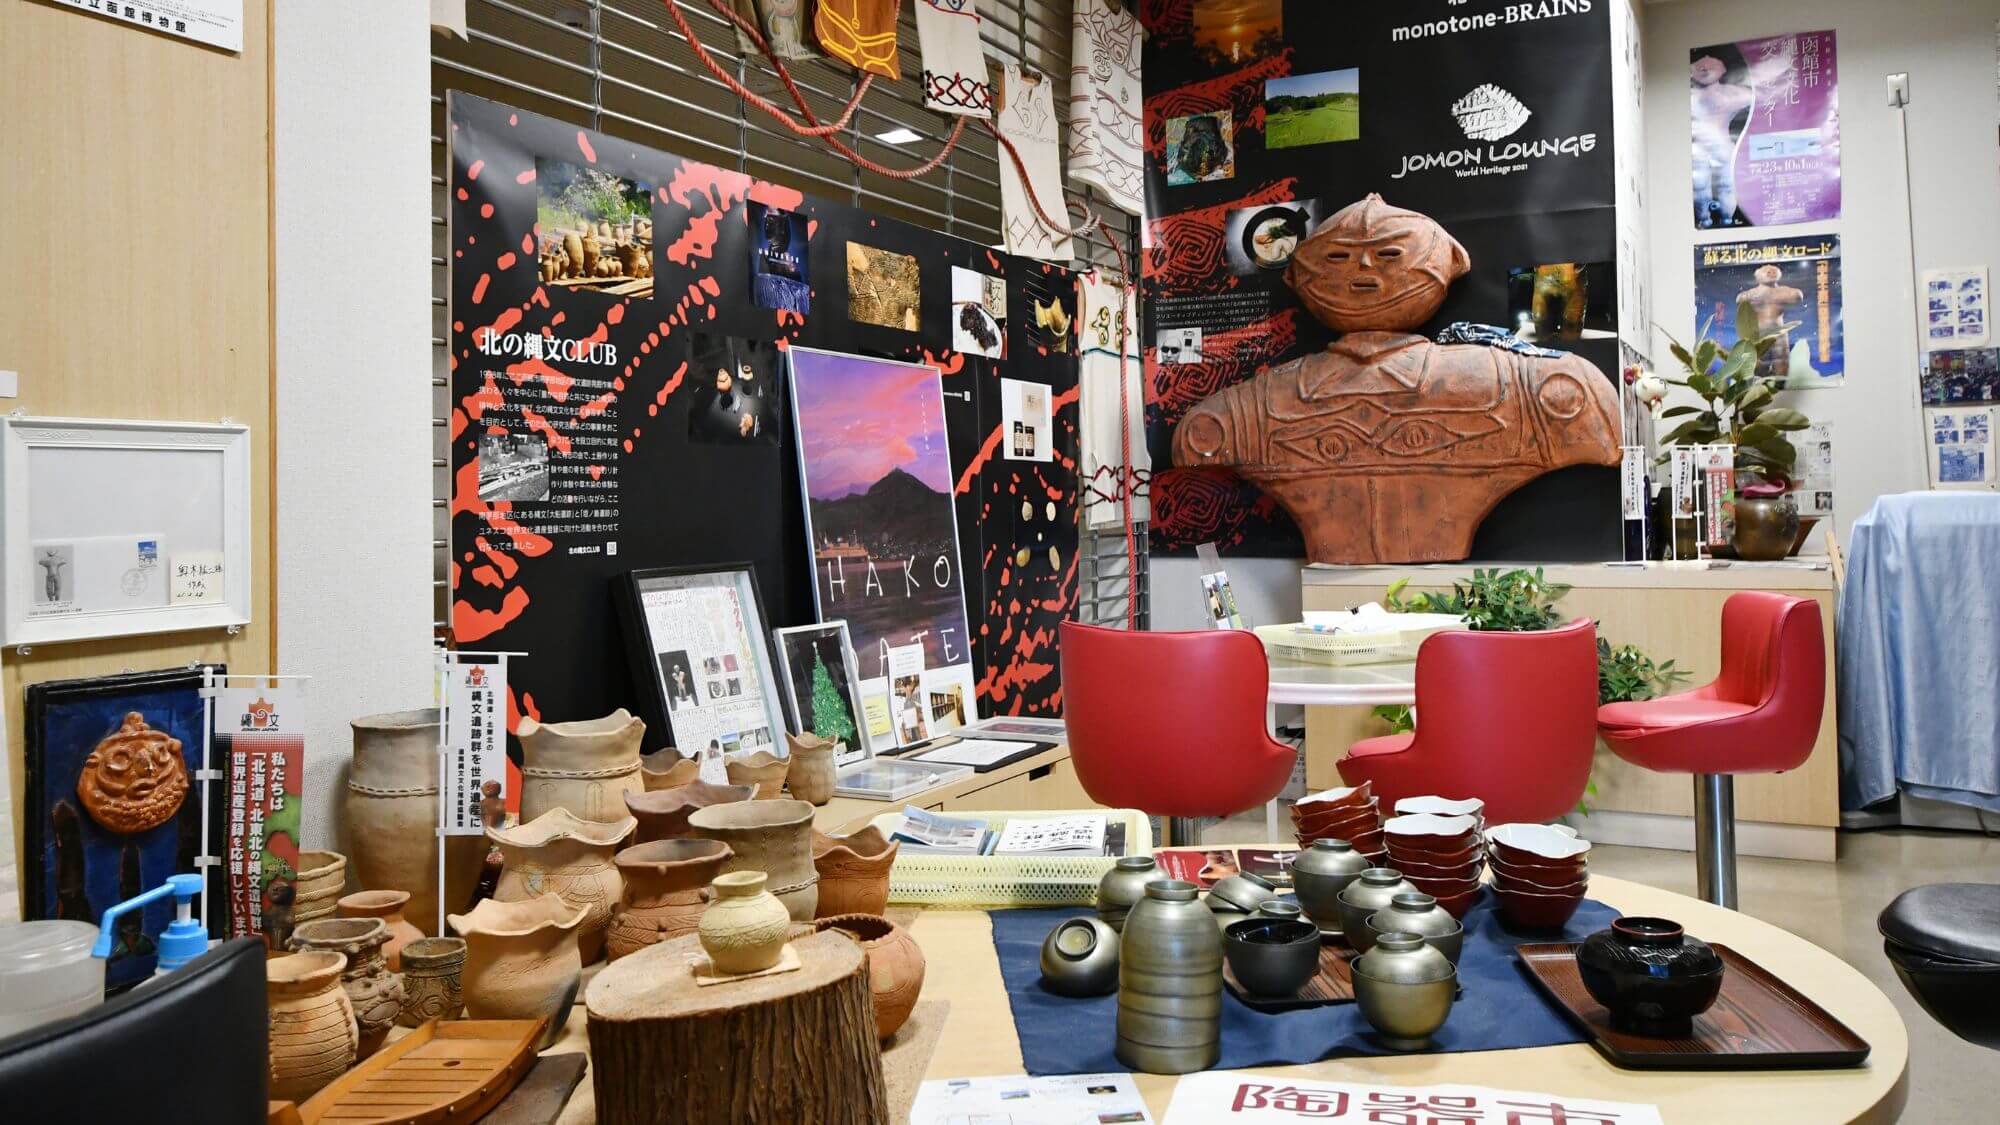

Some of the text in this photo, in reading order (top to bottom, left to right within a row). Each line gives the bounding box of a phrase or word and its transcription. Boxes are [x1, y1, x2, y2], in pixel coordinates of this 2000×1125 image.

[1392, 0, 1592, 41] monotone-BRAINS
[1802, 35, 1820, 89] 函館市
[1391, 134, 1597, 179] JOMON LOUNGE
[1455, 163, 1528, 178] World Heritage 2021
[479, 327, 618, 366] 北の縄文CLUB
[270, 751, 286, 811] 私たちは
[469, 690, 482, 828] 縄文遺跡群を世界遺産に
